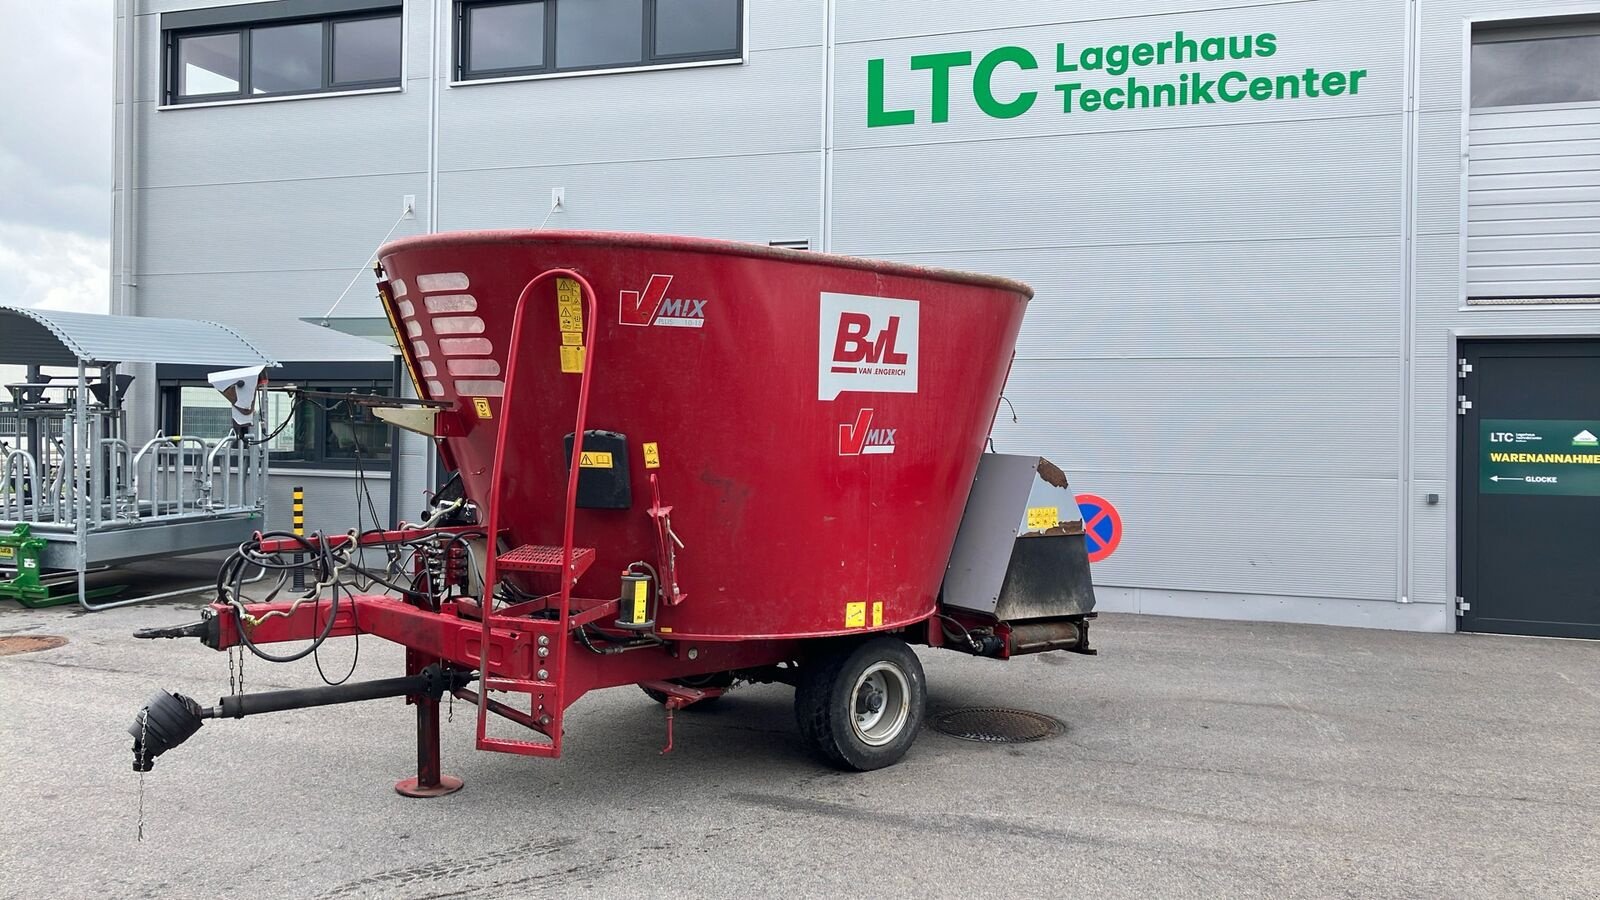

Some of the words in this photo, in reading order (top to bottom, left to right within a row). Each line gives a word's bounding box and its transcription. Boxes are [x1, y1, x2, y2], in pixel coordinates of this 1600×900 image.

[1055, 30, 1278, 76] Lagerhaus
[867, 46, 1039, 128] LTC
[1054, 68, 1368, 114] TechnikCenter
[859, 367, 873, 375] VAN
[873, 368, 906, 376] ENGERICH
[1490, 432, 1514, 443] LTC
[1490, 452, 1600, 464] WARENANNAHME
[1526, 476, 1558, 484] GLOCKE
